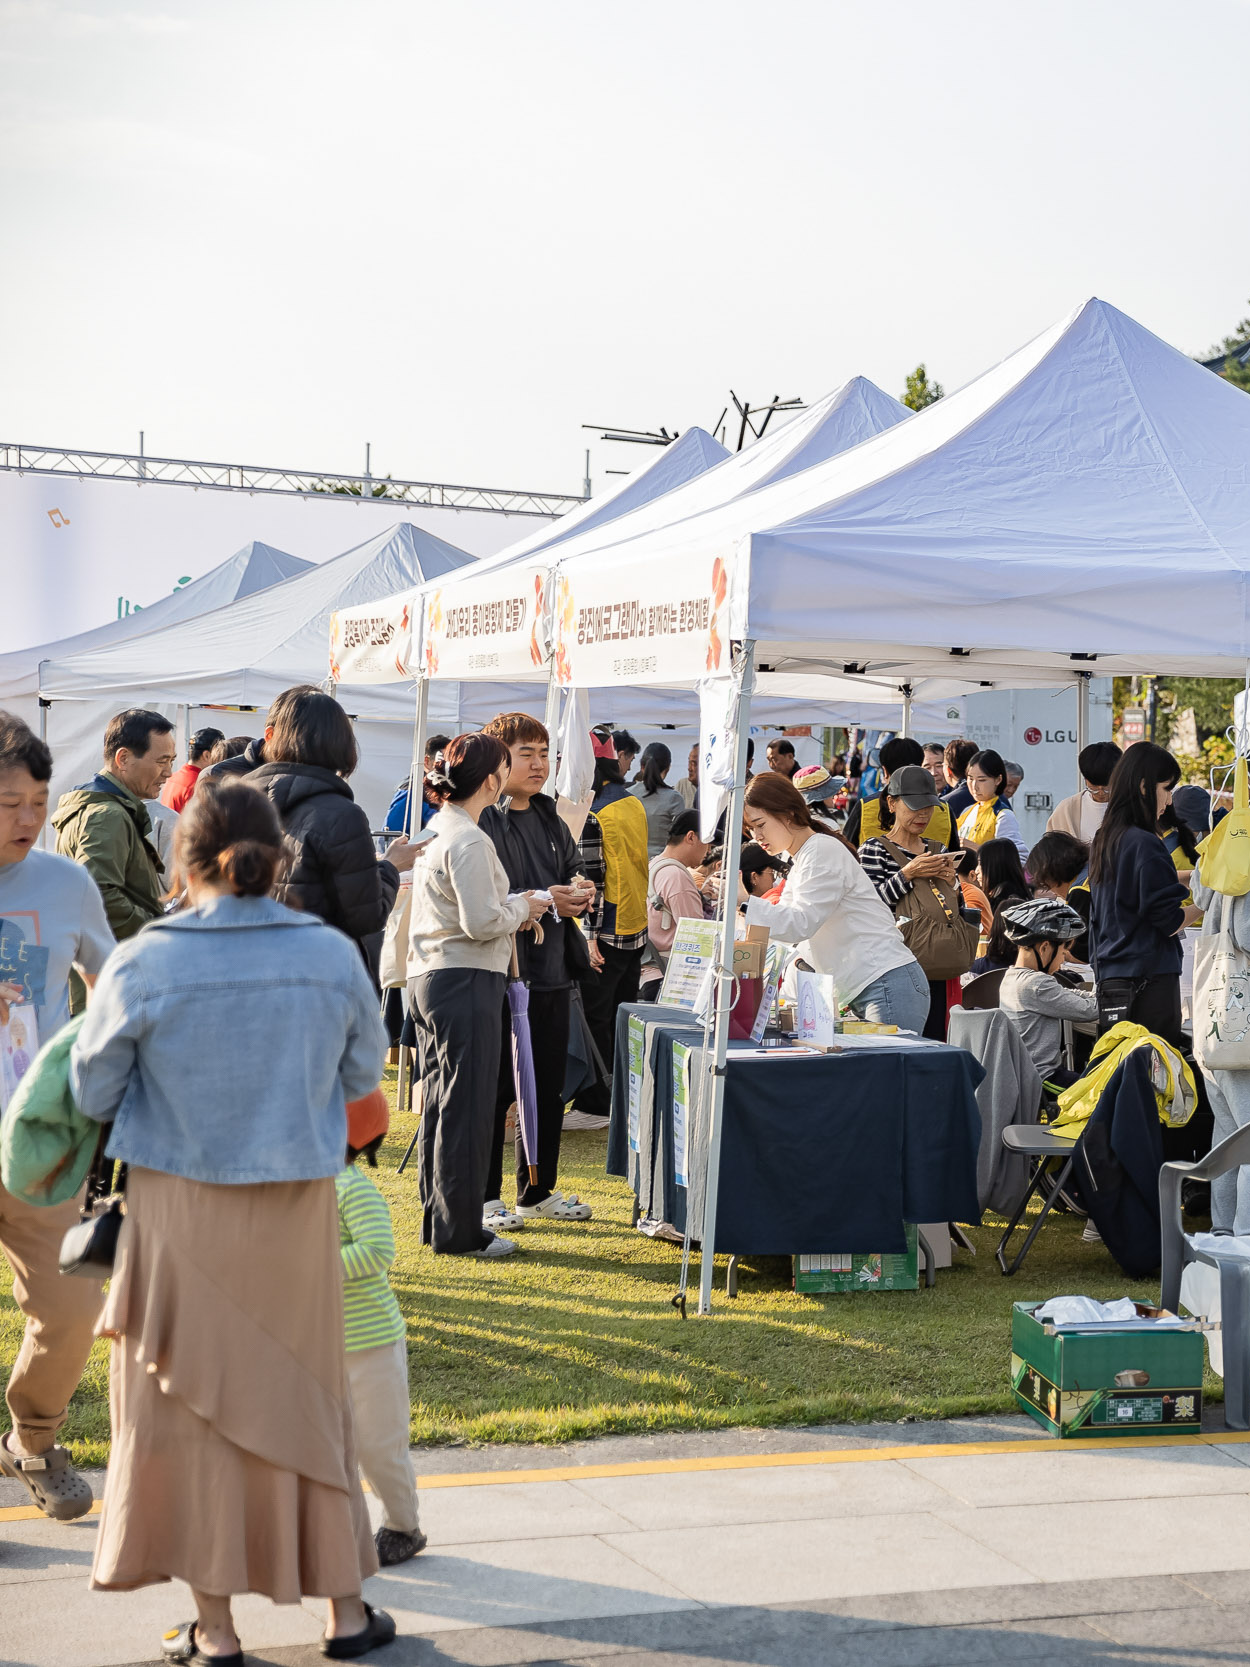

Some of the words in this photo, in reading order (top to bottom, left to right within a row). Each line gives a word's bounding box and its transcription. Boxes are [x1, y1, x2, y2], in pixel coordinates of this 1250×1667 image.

[505, 596, 526, 632] 만들기
[648, 602, 678, 637] 함께하는
[679, 597, 710, 633] 환경체험
[1045, 730, 1066, 743] LG
